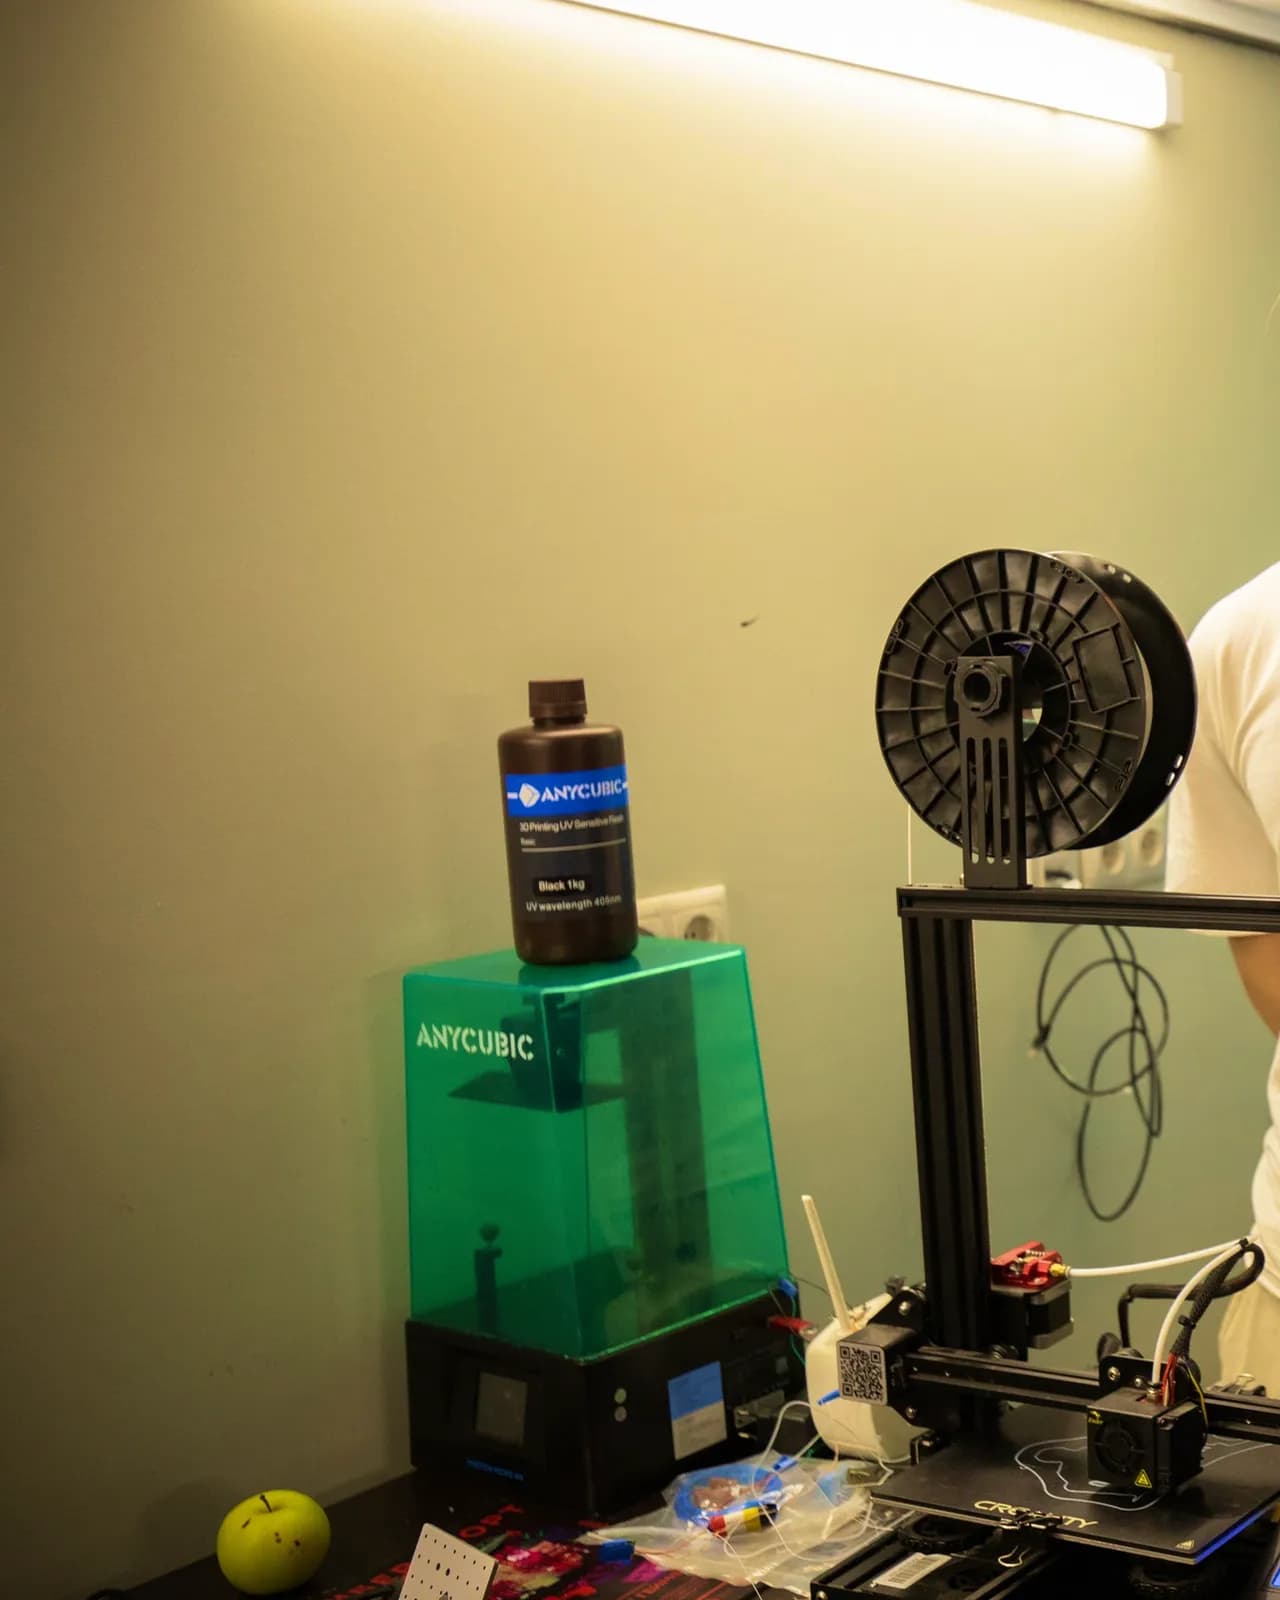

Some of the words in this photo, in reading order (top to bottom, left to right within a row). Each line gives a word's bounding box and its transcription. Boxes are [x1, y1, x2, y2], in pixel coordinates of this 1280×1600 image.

[541, 779, 623, 803] ANYCUBIC
[530, 821, 559, 833] Printing
[560, 820, 574, 832] UV
[538, 879, 566, 892] Black
[567, 879, 586, 891] 1kg
[525, 901, 538, 912] UV
[538, 898, 593, 912] wavelength
[417, 1023, 534, 1060] ANYCUBIC
